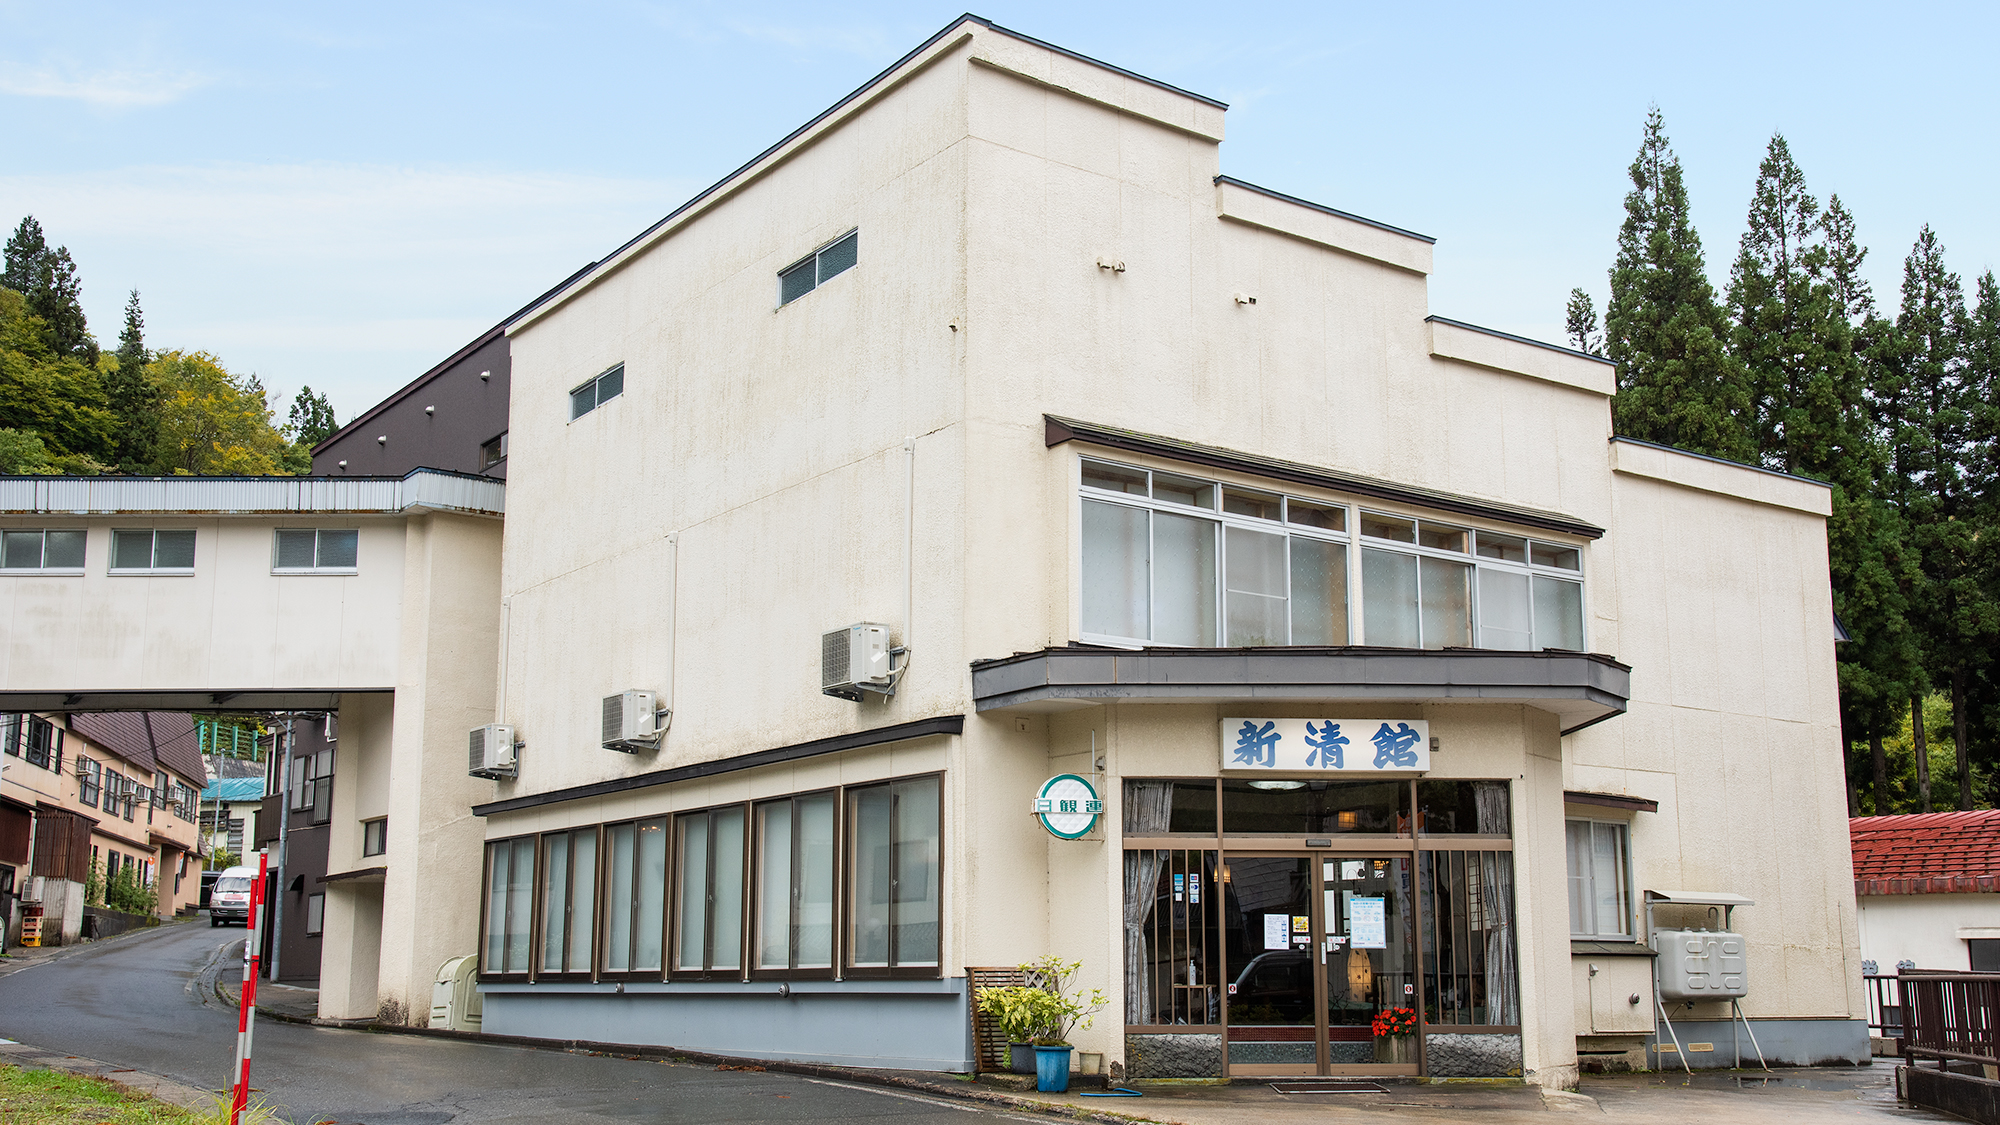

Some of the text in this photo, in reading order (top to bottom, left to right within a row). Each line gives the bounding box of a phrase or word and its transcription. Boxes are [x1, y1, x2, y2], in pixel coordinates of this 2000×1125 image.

[1231, 719, 1422, 769] 新清館
[1037, 799, 1103, 813] 日観連
